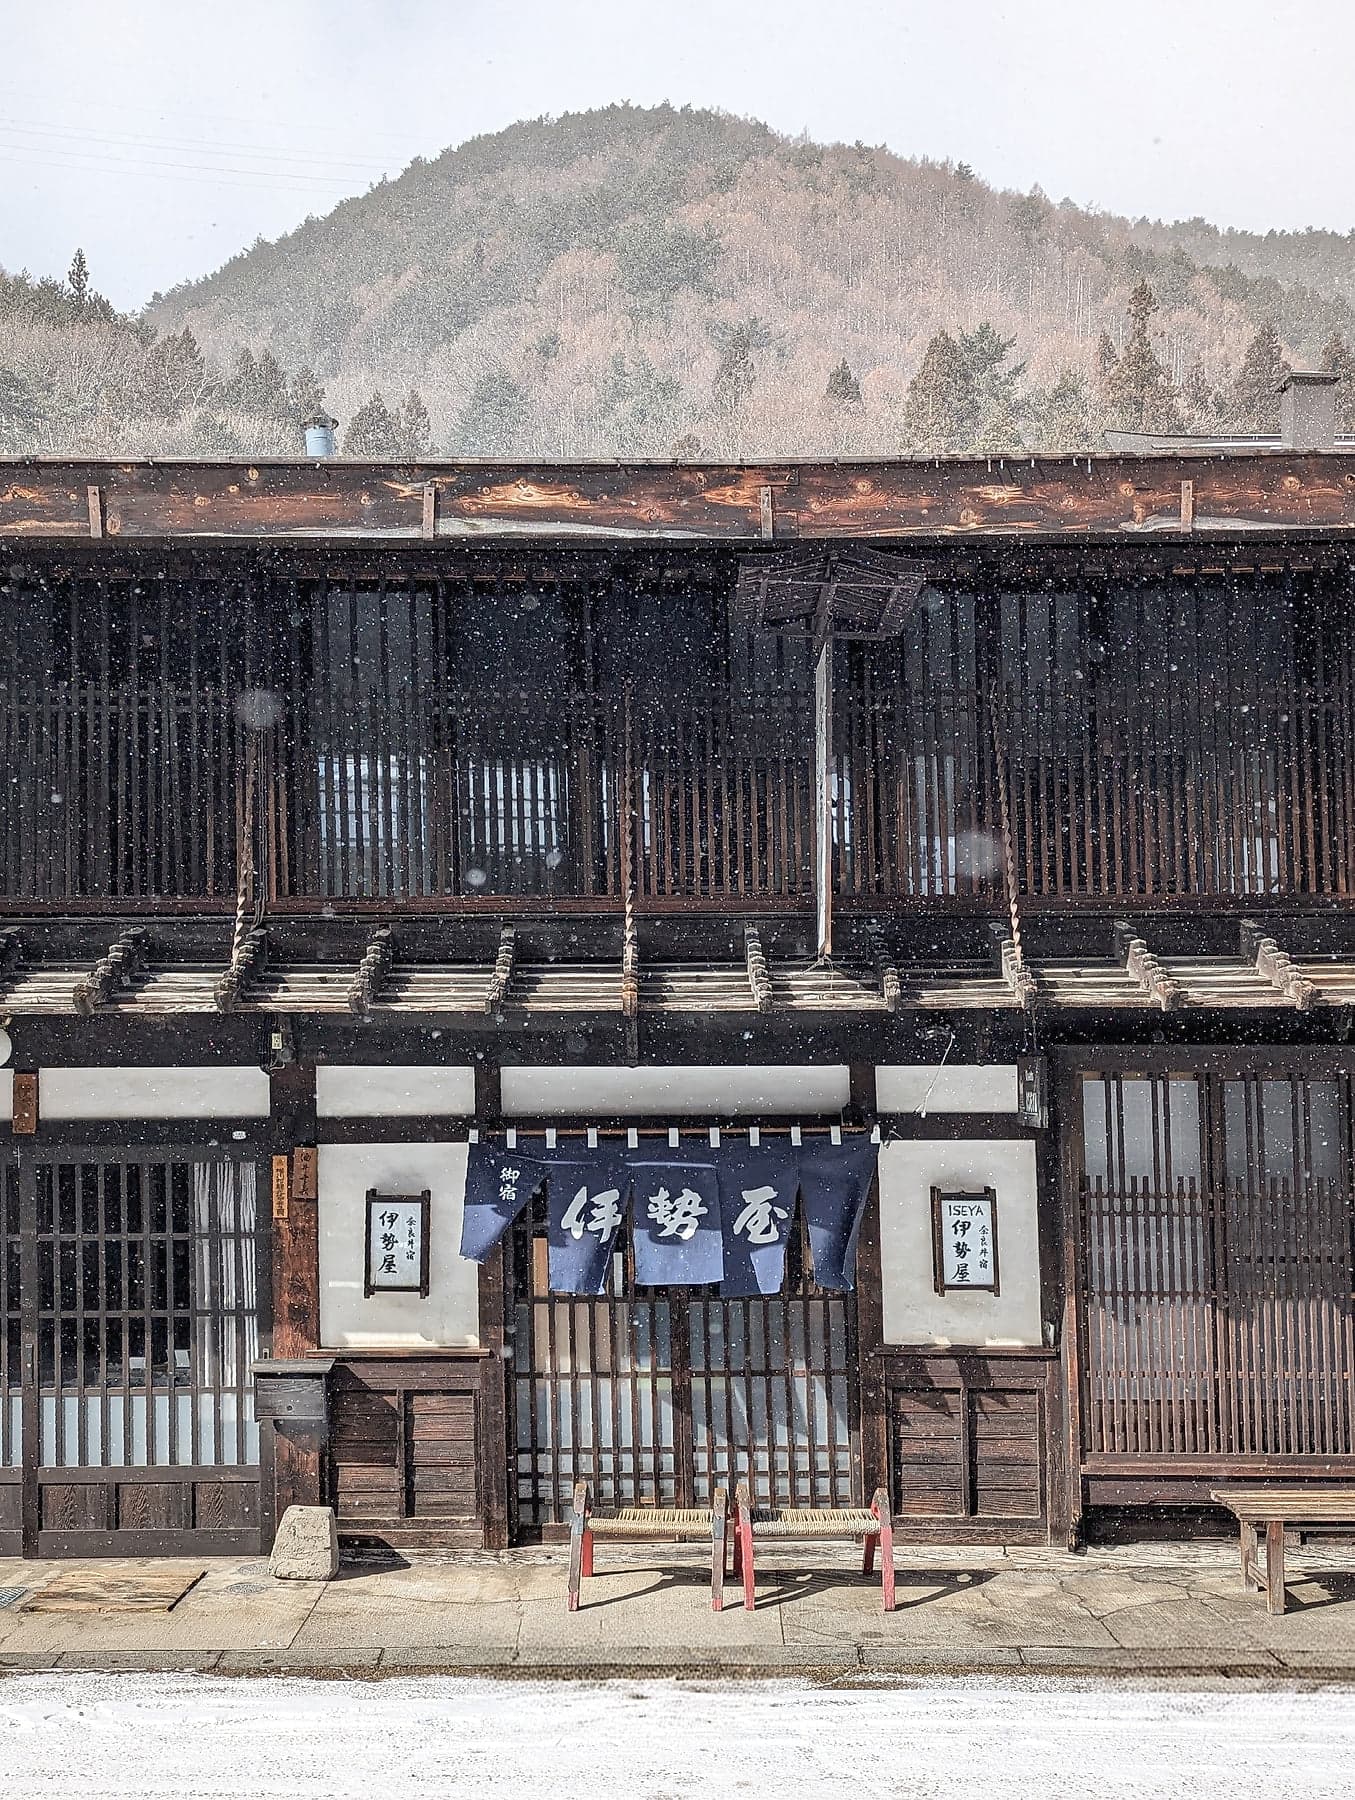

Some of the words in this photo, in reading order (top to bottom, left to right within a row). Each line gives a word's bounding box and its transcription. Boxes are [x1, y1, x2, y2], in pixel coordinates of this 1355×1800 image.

[499, 1166, 521, 1201] 御宿
[561, 1185, 788, 1244] 伊勢屋
[948, 1204, 984, 1217] ISEYA
[378, 1210, 399, 1274] 伊勢屋
[405, 1216, 417, 1261] 奈良井宿
[951, 1219, 971, 1283] 伊勢屋
[978, 1225, 990, 1270] 奈良井宿
